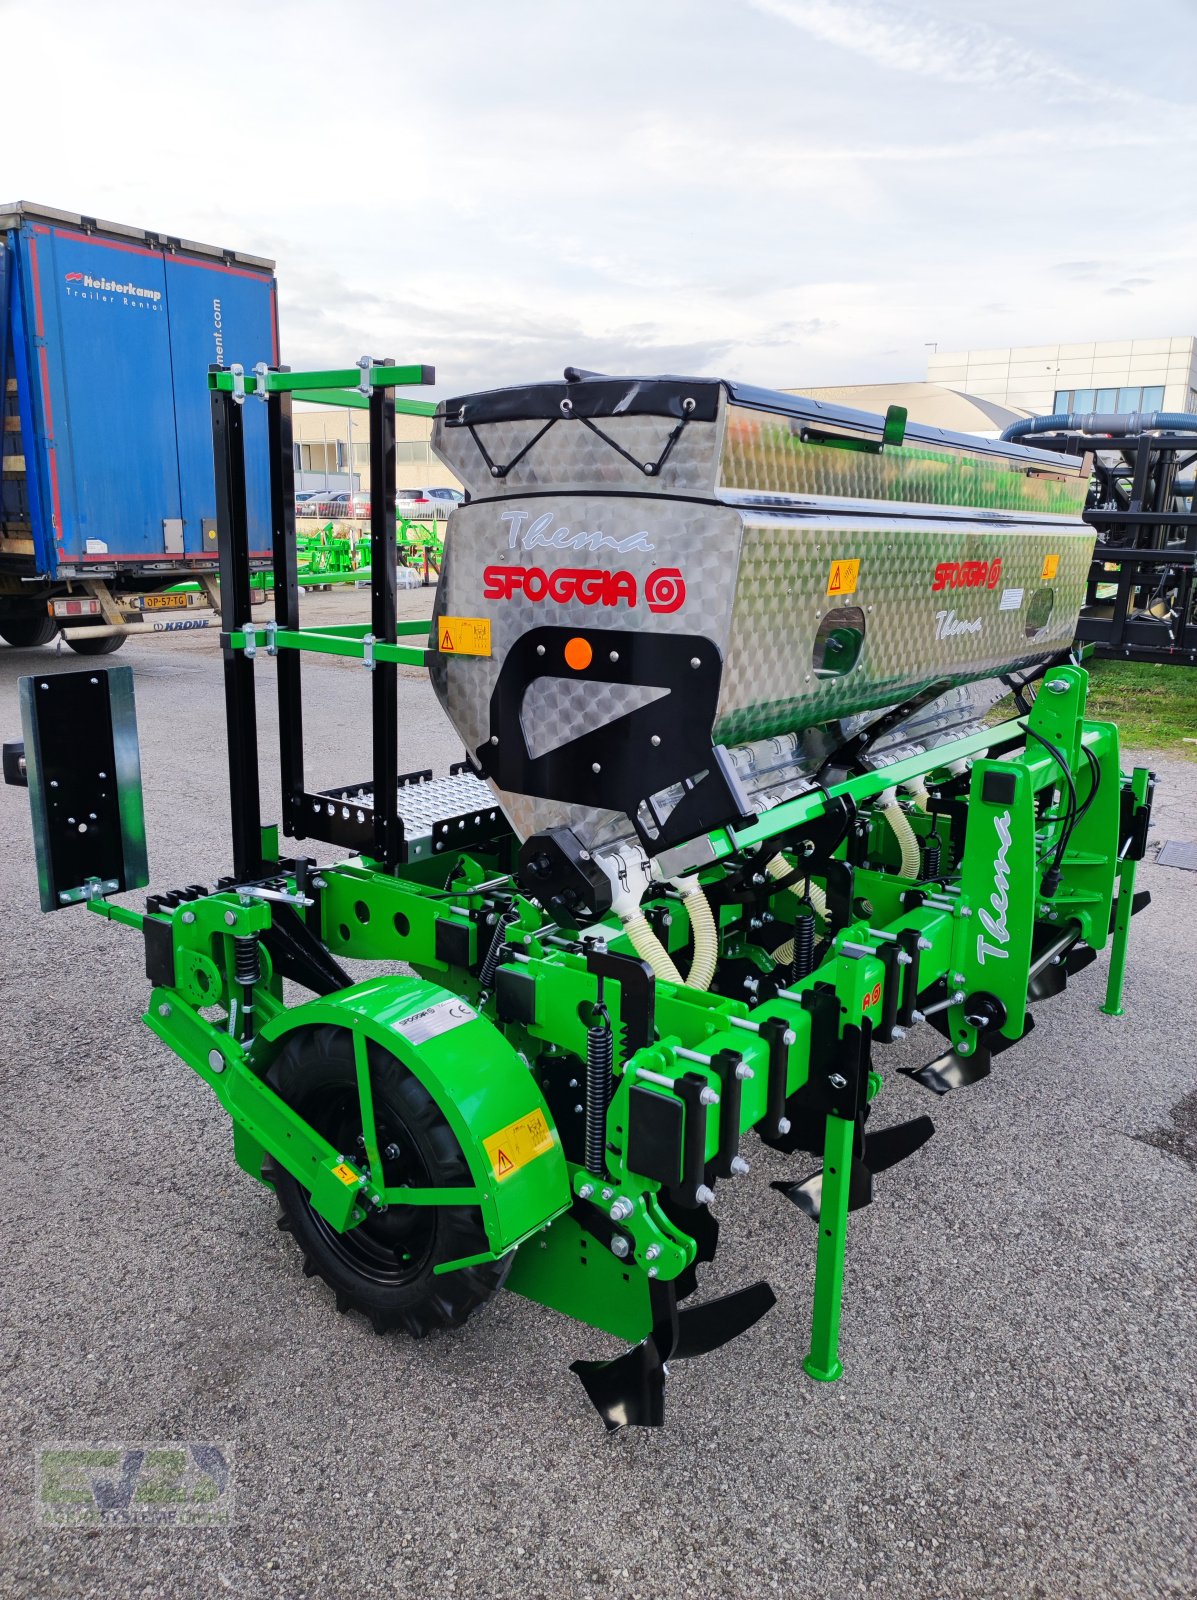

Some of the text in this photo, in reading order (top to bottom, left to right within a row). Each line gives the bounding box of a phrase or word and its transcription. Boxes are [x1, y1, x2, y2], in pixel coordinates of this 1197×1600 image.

[66, 287, 163, 312] Trailer Rental
[83, 275, 161, 301] Heisterkamp
[213, 299, 224, 367] ment.com
[501, 511, 656, 553] Thema
[483, 565, 637, 607] SFOGGIA
[932, 561, 988, 591] SFOGGIA
[147, 597, 184, 606] OP-57-TG
[165, 620, 210, 631] KRONE
[935, 610, 982, 640] Thema
[977, 810, 1012, 965] Thema
